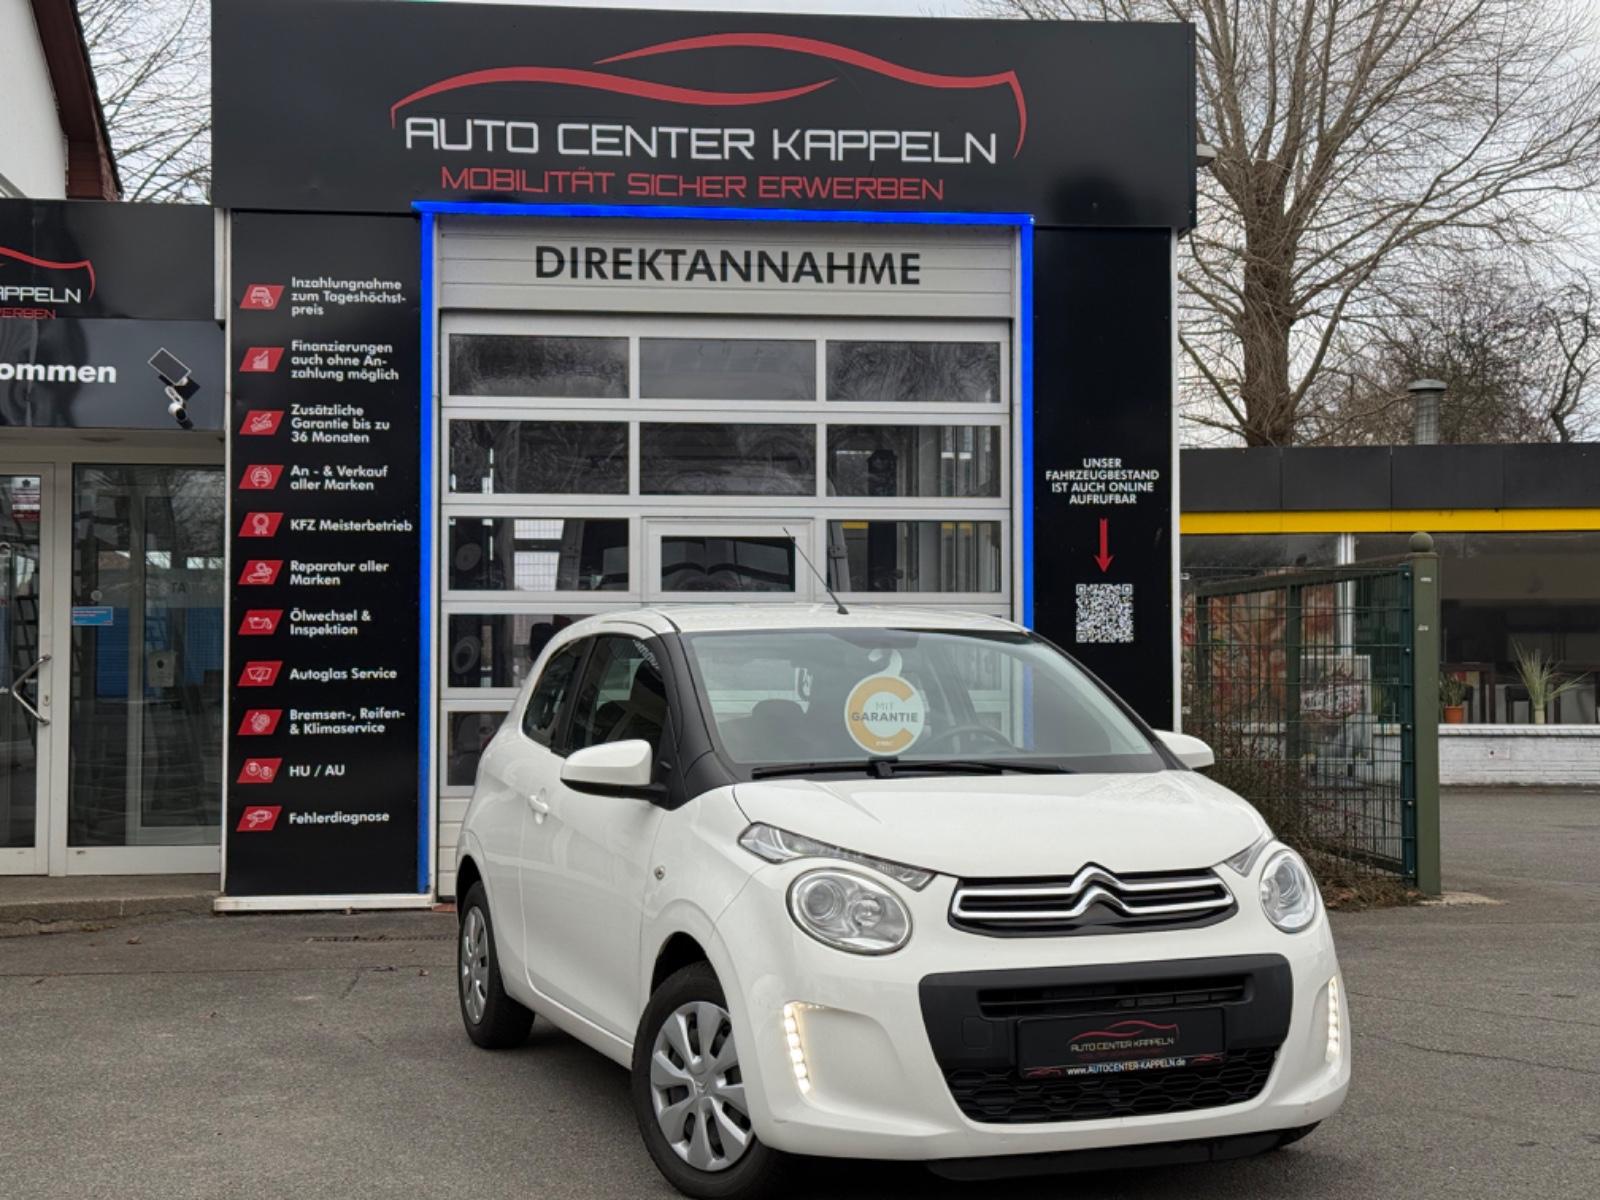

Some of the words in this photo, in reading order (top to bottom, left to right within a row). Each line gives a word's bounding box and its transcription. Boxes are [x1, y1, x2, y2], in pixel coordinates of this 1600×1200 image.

[405, 117, 540, 155] AUTO
[557, 122, 755, 161] CENTER
[772, 127, 997, 165] KAPPELN
[441, 165, 616, 194] MOBILITÄT
[626, 171, 747, 199] SICHER
[757, 175, 944, 201] ERWERBEN
[535, 245, 921, 285] DIREKTANNAHME
[291, 276, 402, 290] Inzahlungnahme
[0, 285, 81, 303] PPELN
[291, 291, 319, 301] zum
[323, 290, 406, 304] Tageshöchst-
[291, 303, 324, 316] preis
[291, 340, 393, 354] Finanzierungen
[291, 354, 323, 365] auch
[326, 355, 360, 366] ohne
[363, 354, 387, 366] An-
[0, 362, 116, 383] ommen
[291, 368, 343, 381] zahlung
[347, 368, 399, 382] möglich
[291, 403, 364, 416] Zusätzliche
[291, 417, 348, 429] Garantie
[352, 418, 371, 431] bis
[375, 420, 390, 431] zu
[291, 431, 308, 442] 36
[312, 432, 369, 443] Monaten
[1083, 457, 1121, 468] UNSER
[290, 464, 309, 476] An
[323, 465, 333, 477] &
[336, 465, 388, 477] Verkauf
[1045, 469, 1159, 481] FAHRZEUGBESTAND
[290, 478, 320, 490] aller
[324, 479, 374, 490] Marken
[1051, 482, 1067, 493] IST
[1071, 481, 1105, 493] AUCH
[1108, 481, 1154, 492] ONLINE
[1069, 494, 1137, 504] AUFRUFBAR
[290, 519, 316, 531] KFZ
[319, 519, 412, 531] Meisterbetrieb
[290, 560, 355, 574] Reparatur
[358, 560, 389, 572] aller
[290, 574, 340, 585] Marken
[290, 608, 357, 621] Ölwechsel
[361, 610, 371, 621] &
[290, 623, 357, 637] Inspektion
[289, 667, 347, 682] Autoglas
[351, 667, 397, 679] Service
[289, 708, 356, 721] Bremsen-,
[359, 707, 405, 719] Reifen-
[851, 711, 919, 723] GARANTIE
[289, 723, 299, 734] &
[303, 722, 385, 735] Klimaservice
[289, 765, 310, 776] HU
[324, 764, 345, 776] AU
[289, 811, 389, 825] Fehlerdiagnose
[1071, 1043, 1095, 1051] AUTO
[1097, 1040, 1132, 1050] CENTER
[1066, 1058, 1185, 1074] www.AUTOCENTER-KAPPELN.de
